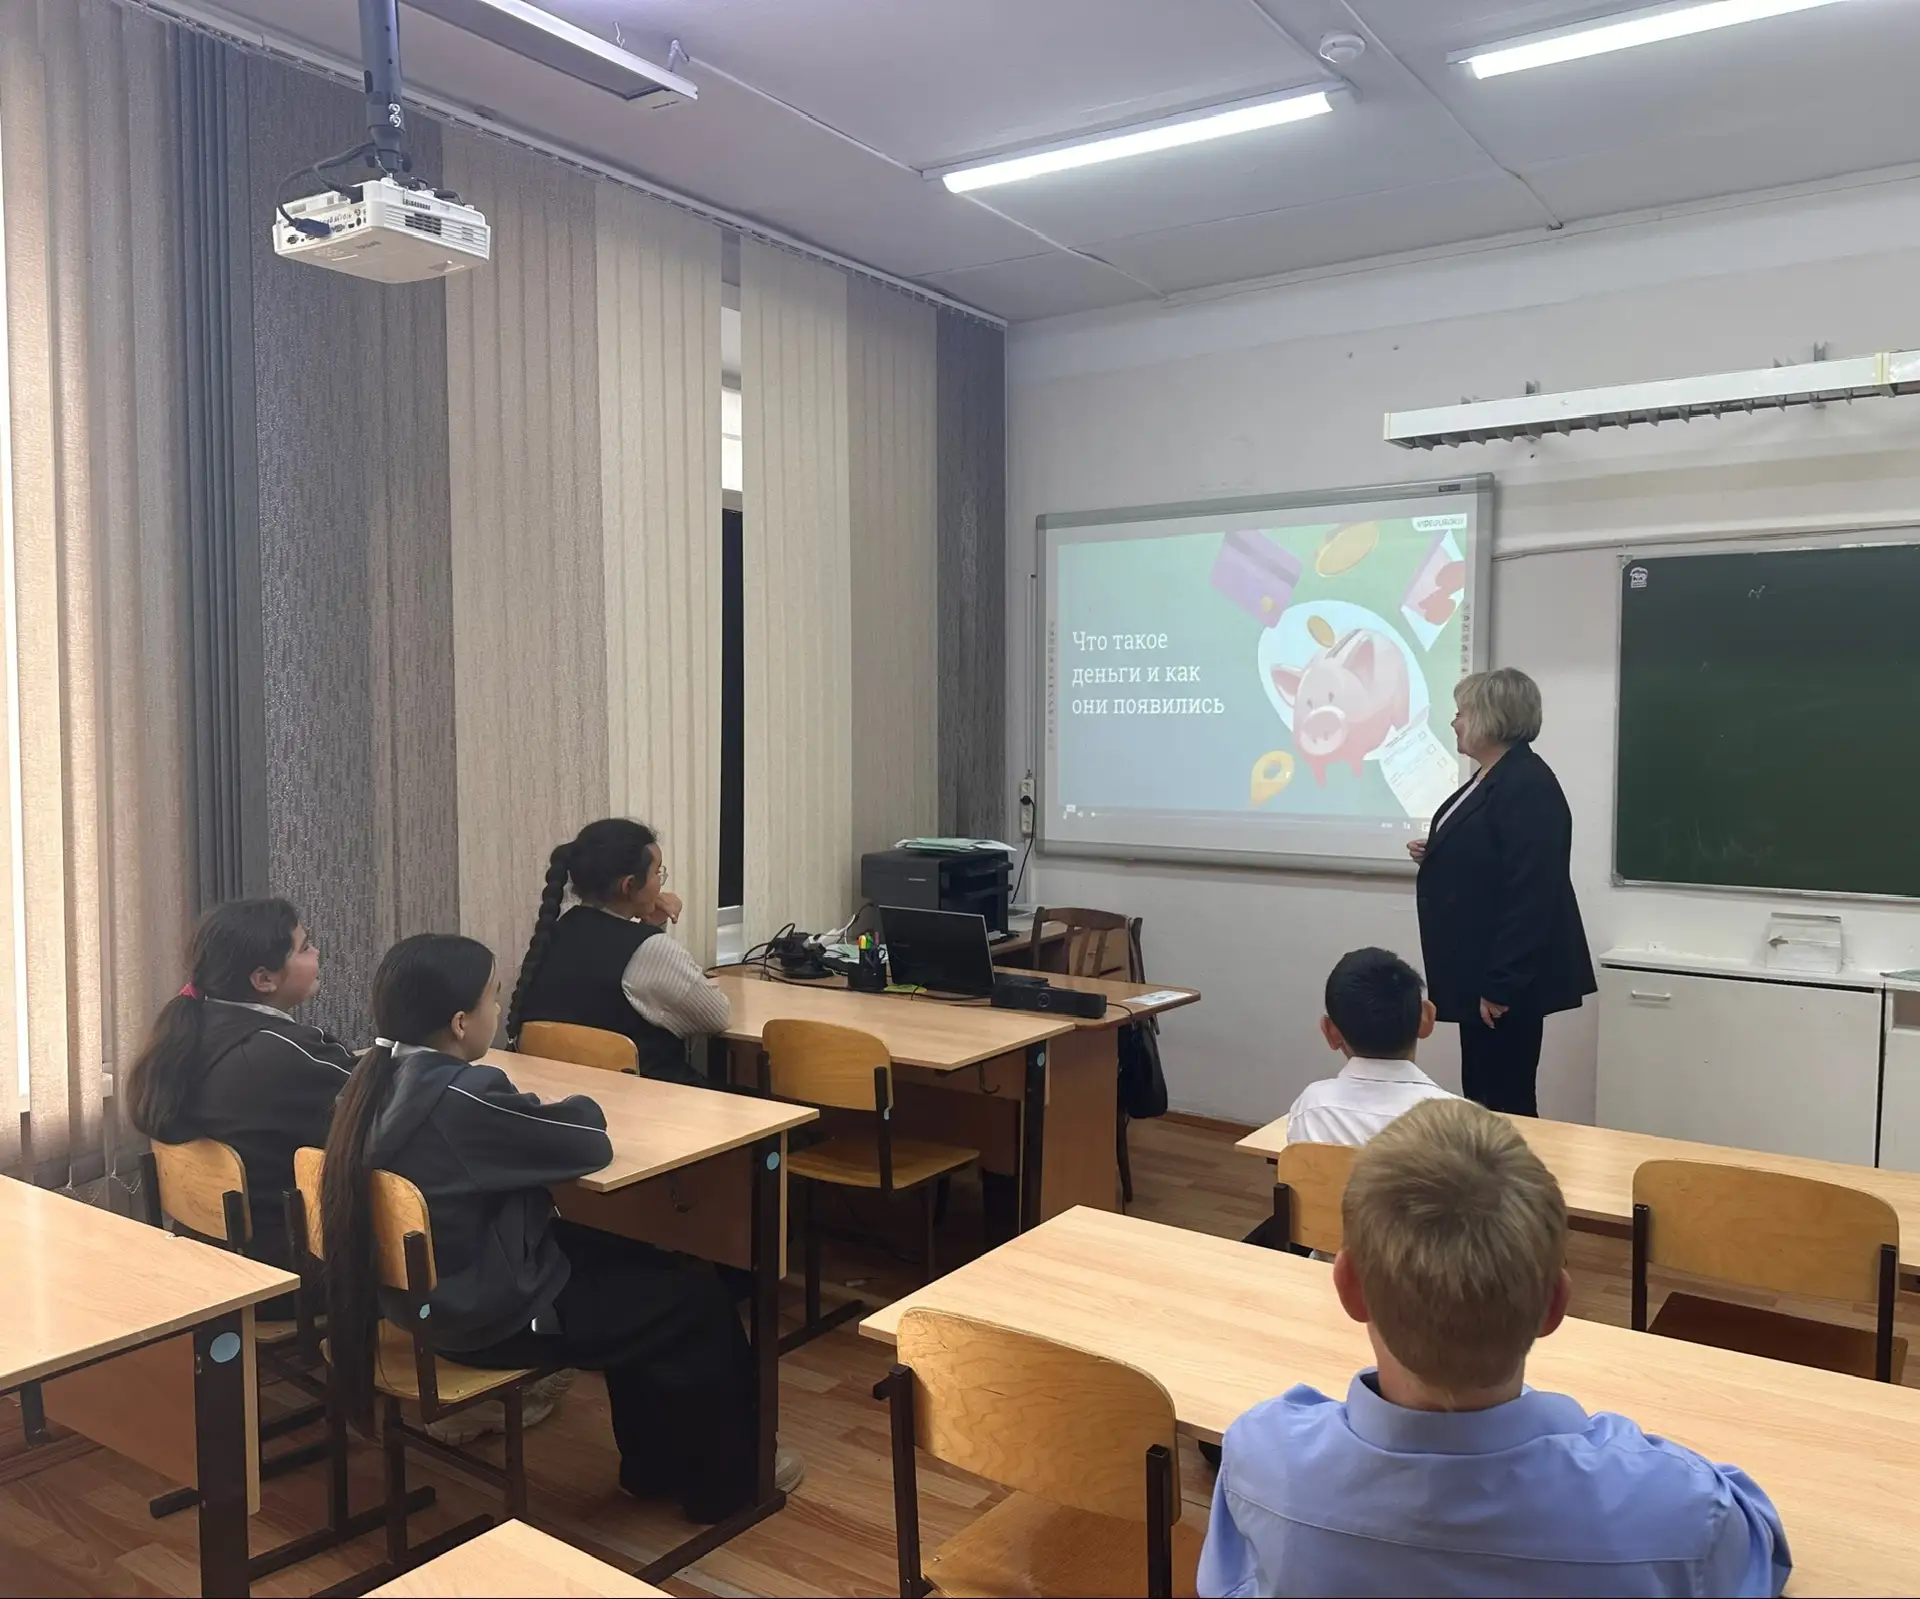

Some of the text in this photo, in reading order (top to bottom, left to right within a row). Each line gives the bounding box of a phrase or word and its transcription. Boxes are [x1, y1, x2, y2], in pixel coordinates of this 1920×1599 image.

[1072, 631, 1168, 651] Что такое
[1072, 665, 1201, 688] деньги и как
[1072, 697, 1225, 714] они появились
